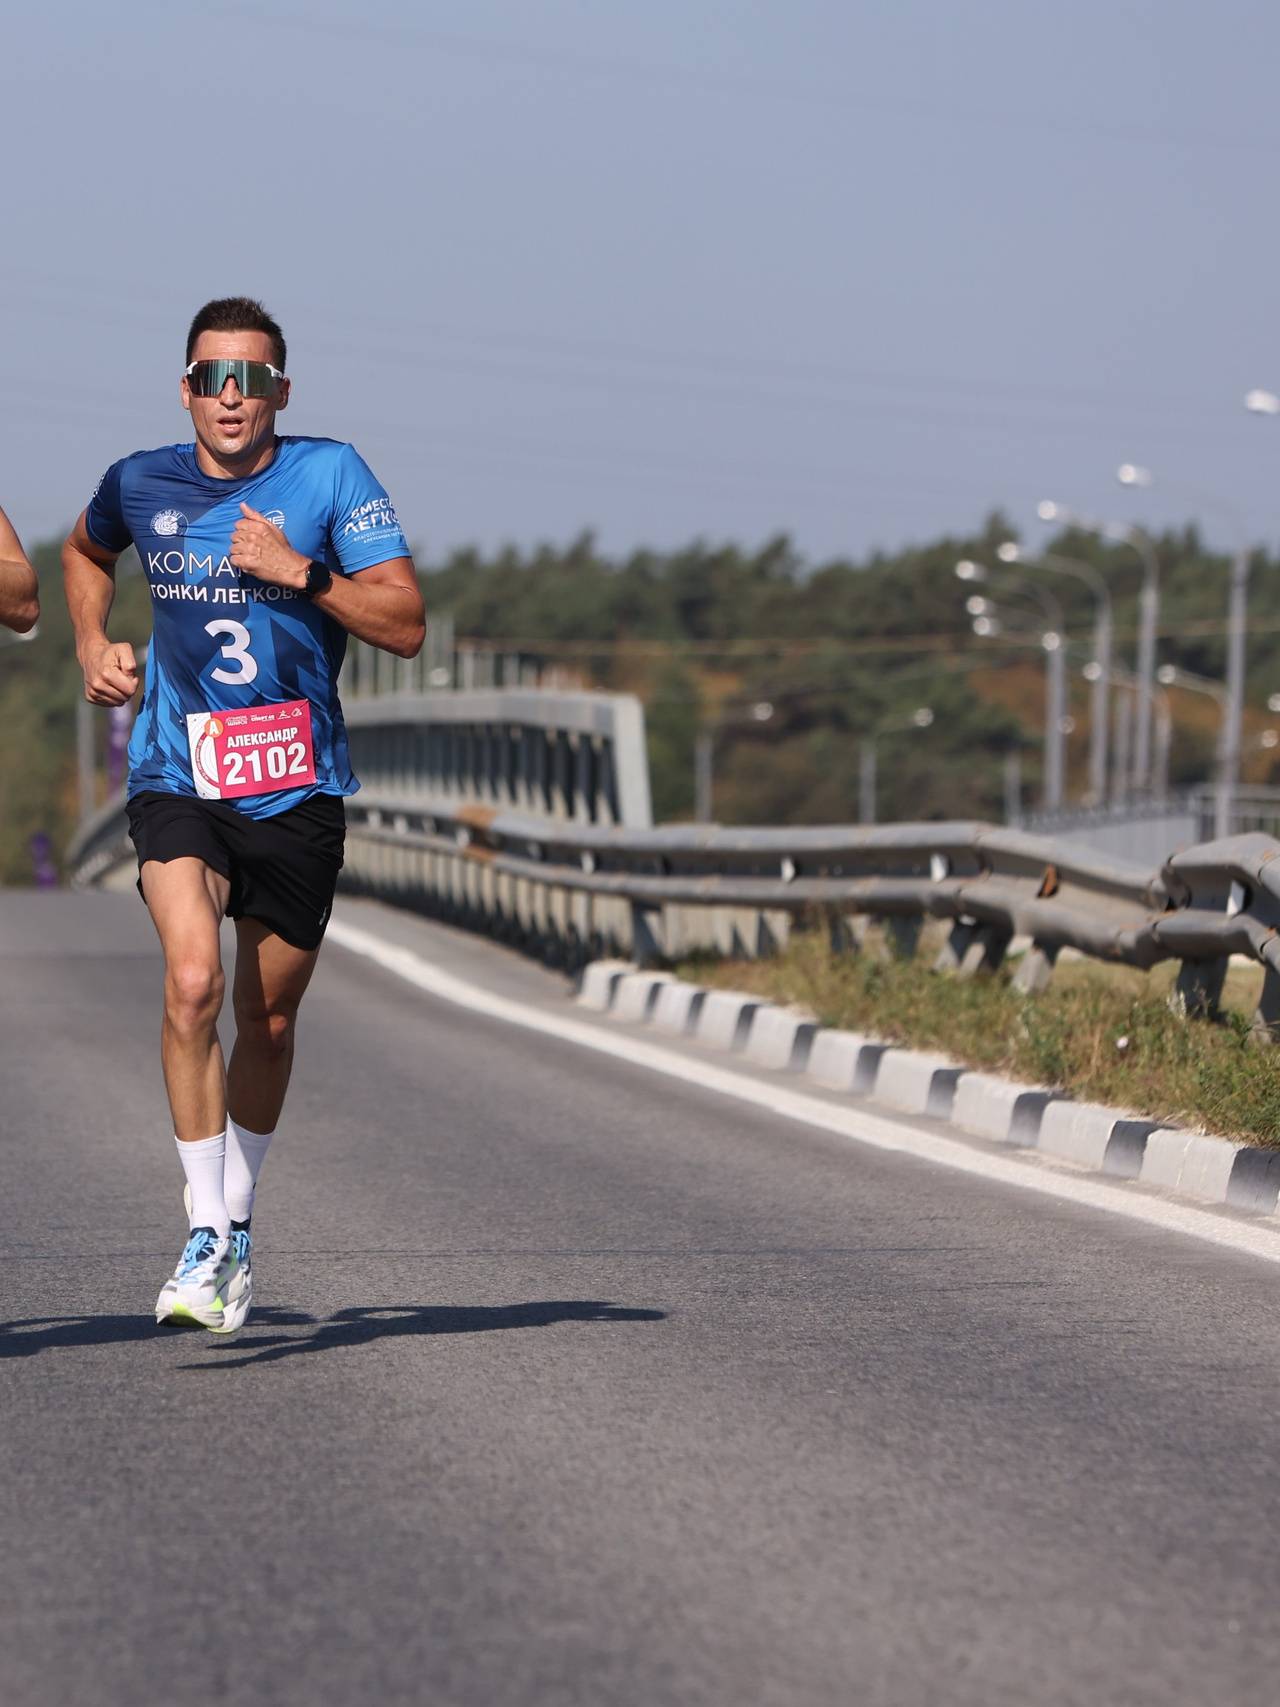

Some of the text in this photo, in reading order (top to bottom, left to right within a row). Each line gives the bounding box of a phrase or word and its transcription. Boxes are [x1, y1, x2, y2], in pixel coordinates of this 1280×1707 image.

[150, 584, 299, 604] ГОНКИ ЛЕГКОВ
[203, 619, 258, 686] 3
[209, 721, 219, 735] А
[227, 727, 298, 748] АЛЕКСАНДР
[222, 742, 308, 786] 2102
